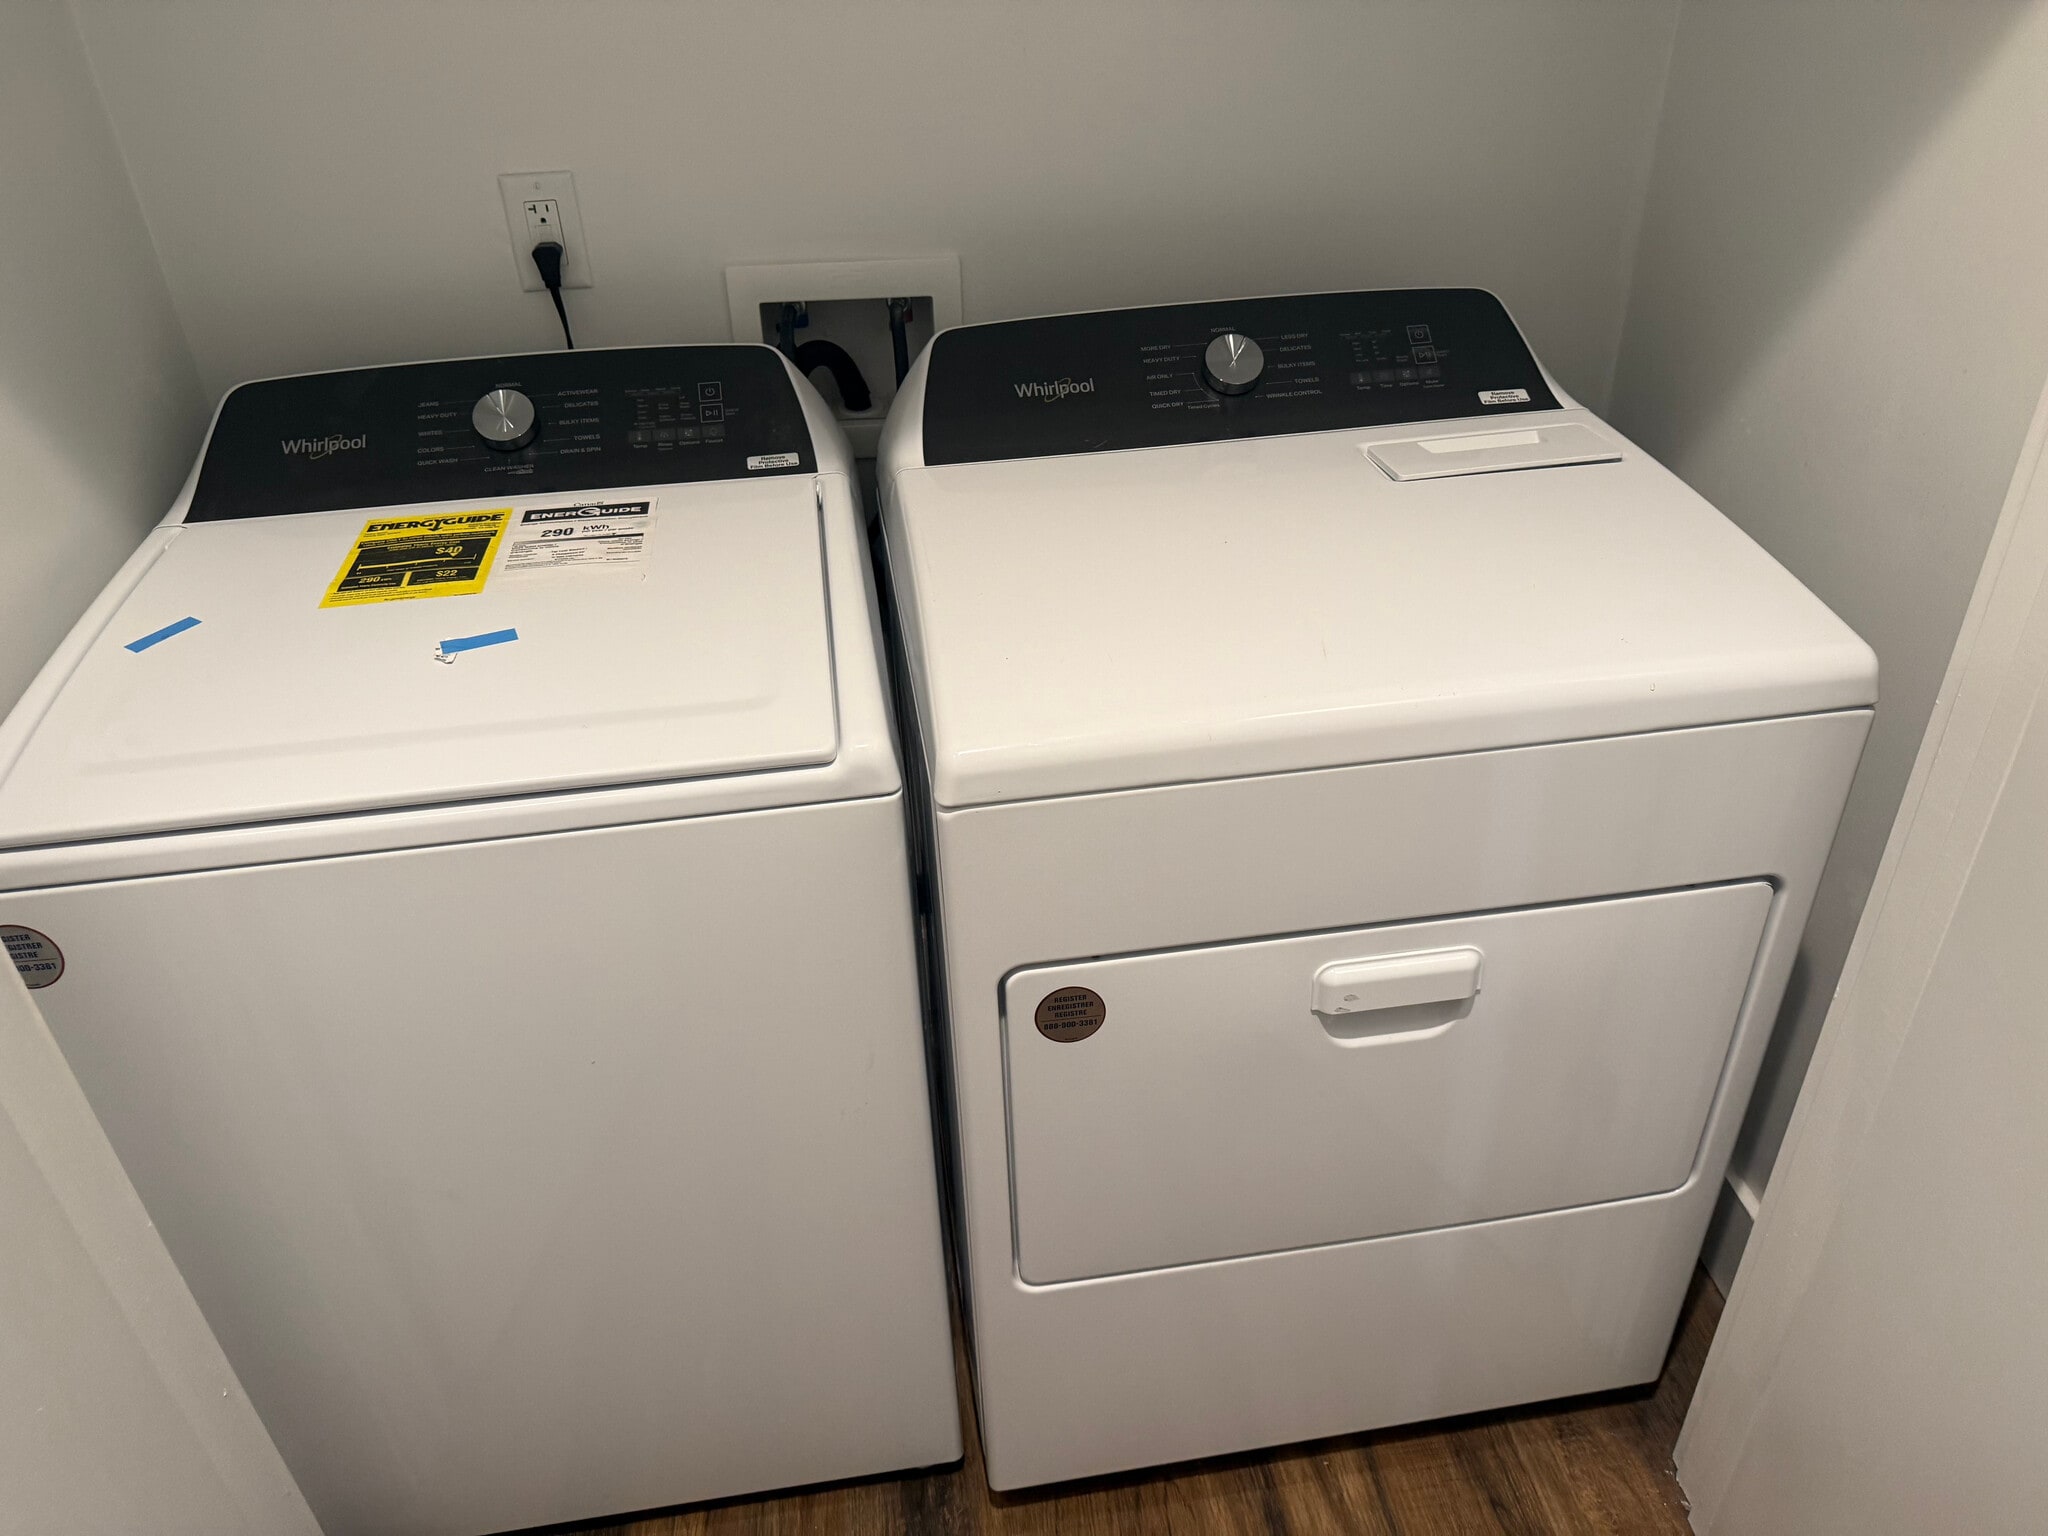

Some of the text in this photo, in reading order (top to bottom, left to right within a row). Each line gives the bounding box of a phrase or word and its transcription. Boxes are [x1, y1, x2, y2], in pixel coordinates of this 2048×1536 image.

[557, 388, 599, 397] ACTIVEWEAR
[1014, 378, 1095, 401] Whirlpool
[281, 434, 366, 458] Whirlpool
[417, 446, 445, 454] COLORS
[540, 527, 574, 538] 290
[358, 576, 381, 584] 290
[1054, 994, 1087, 1003] REGISTER
[1047, 1001, 1094, 1012] ENREGISTRER
